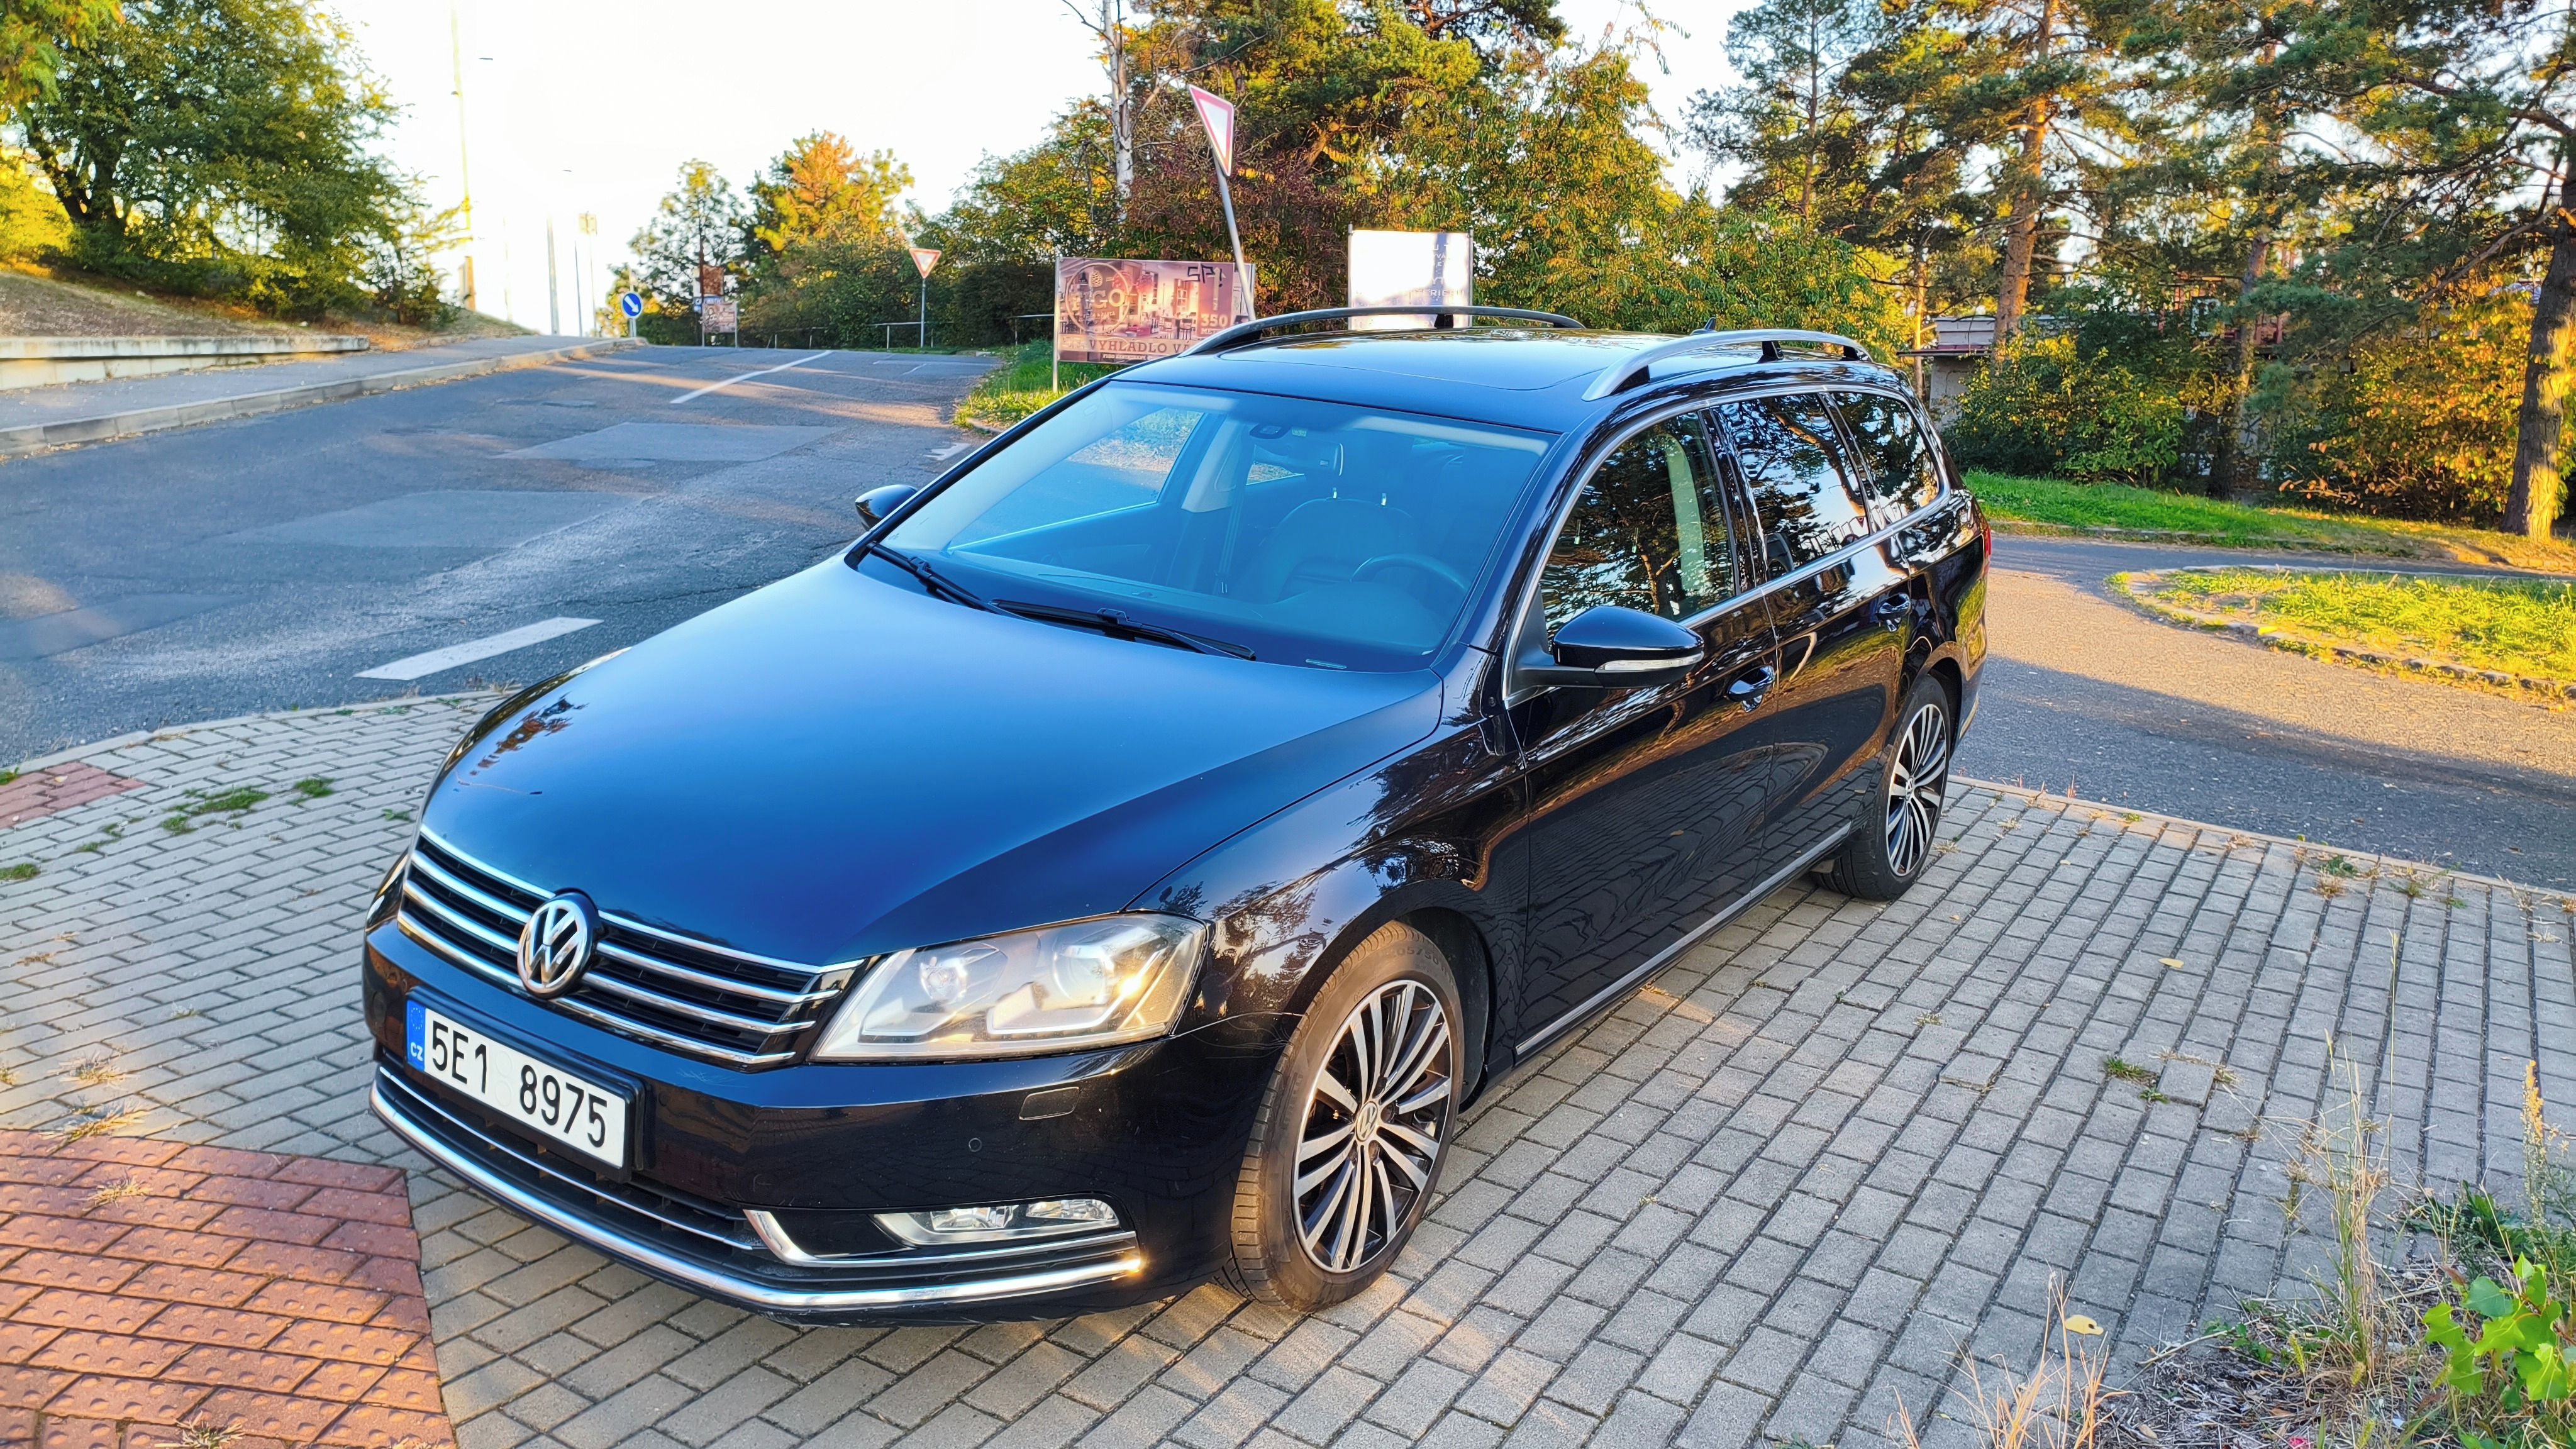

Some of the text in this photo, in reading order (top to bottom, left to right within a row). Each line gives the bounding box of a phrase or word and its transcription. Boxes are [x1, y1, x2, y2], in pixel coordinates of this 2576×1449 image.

[1201, 313, 1228, 328] 350
[1089, 338, 1193, 353] VYHLÁDLO VÁ
[410, 1041, 423, 1062] CZ
[432, 1020, 608, 1148] 5E1 8975
